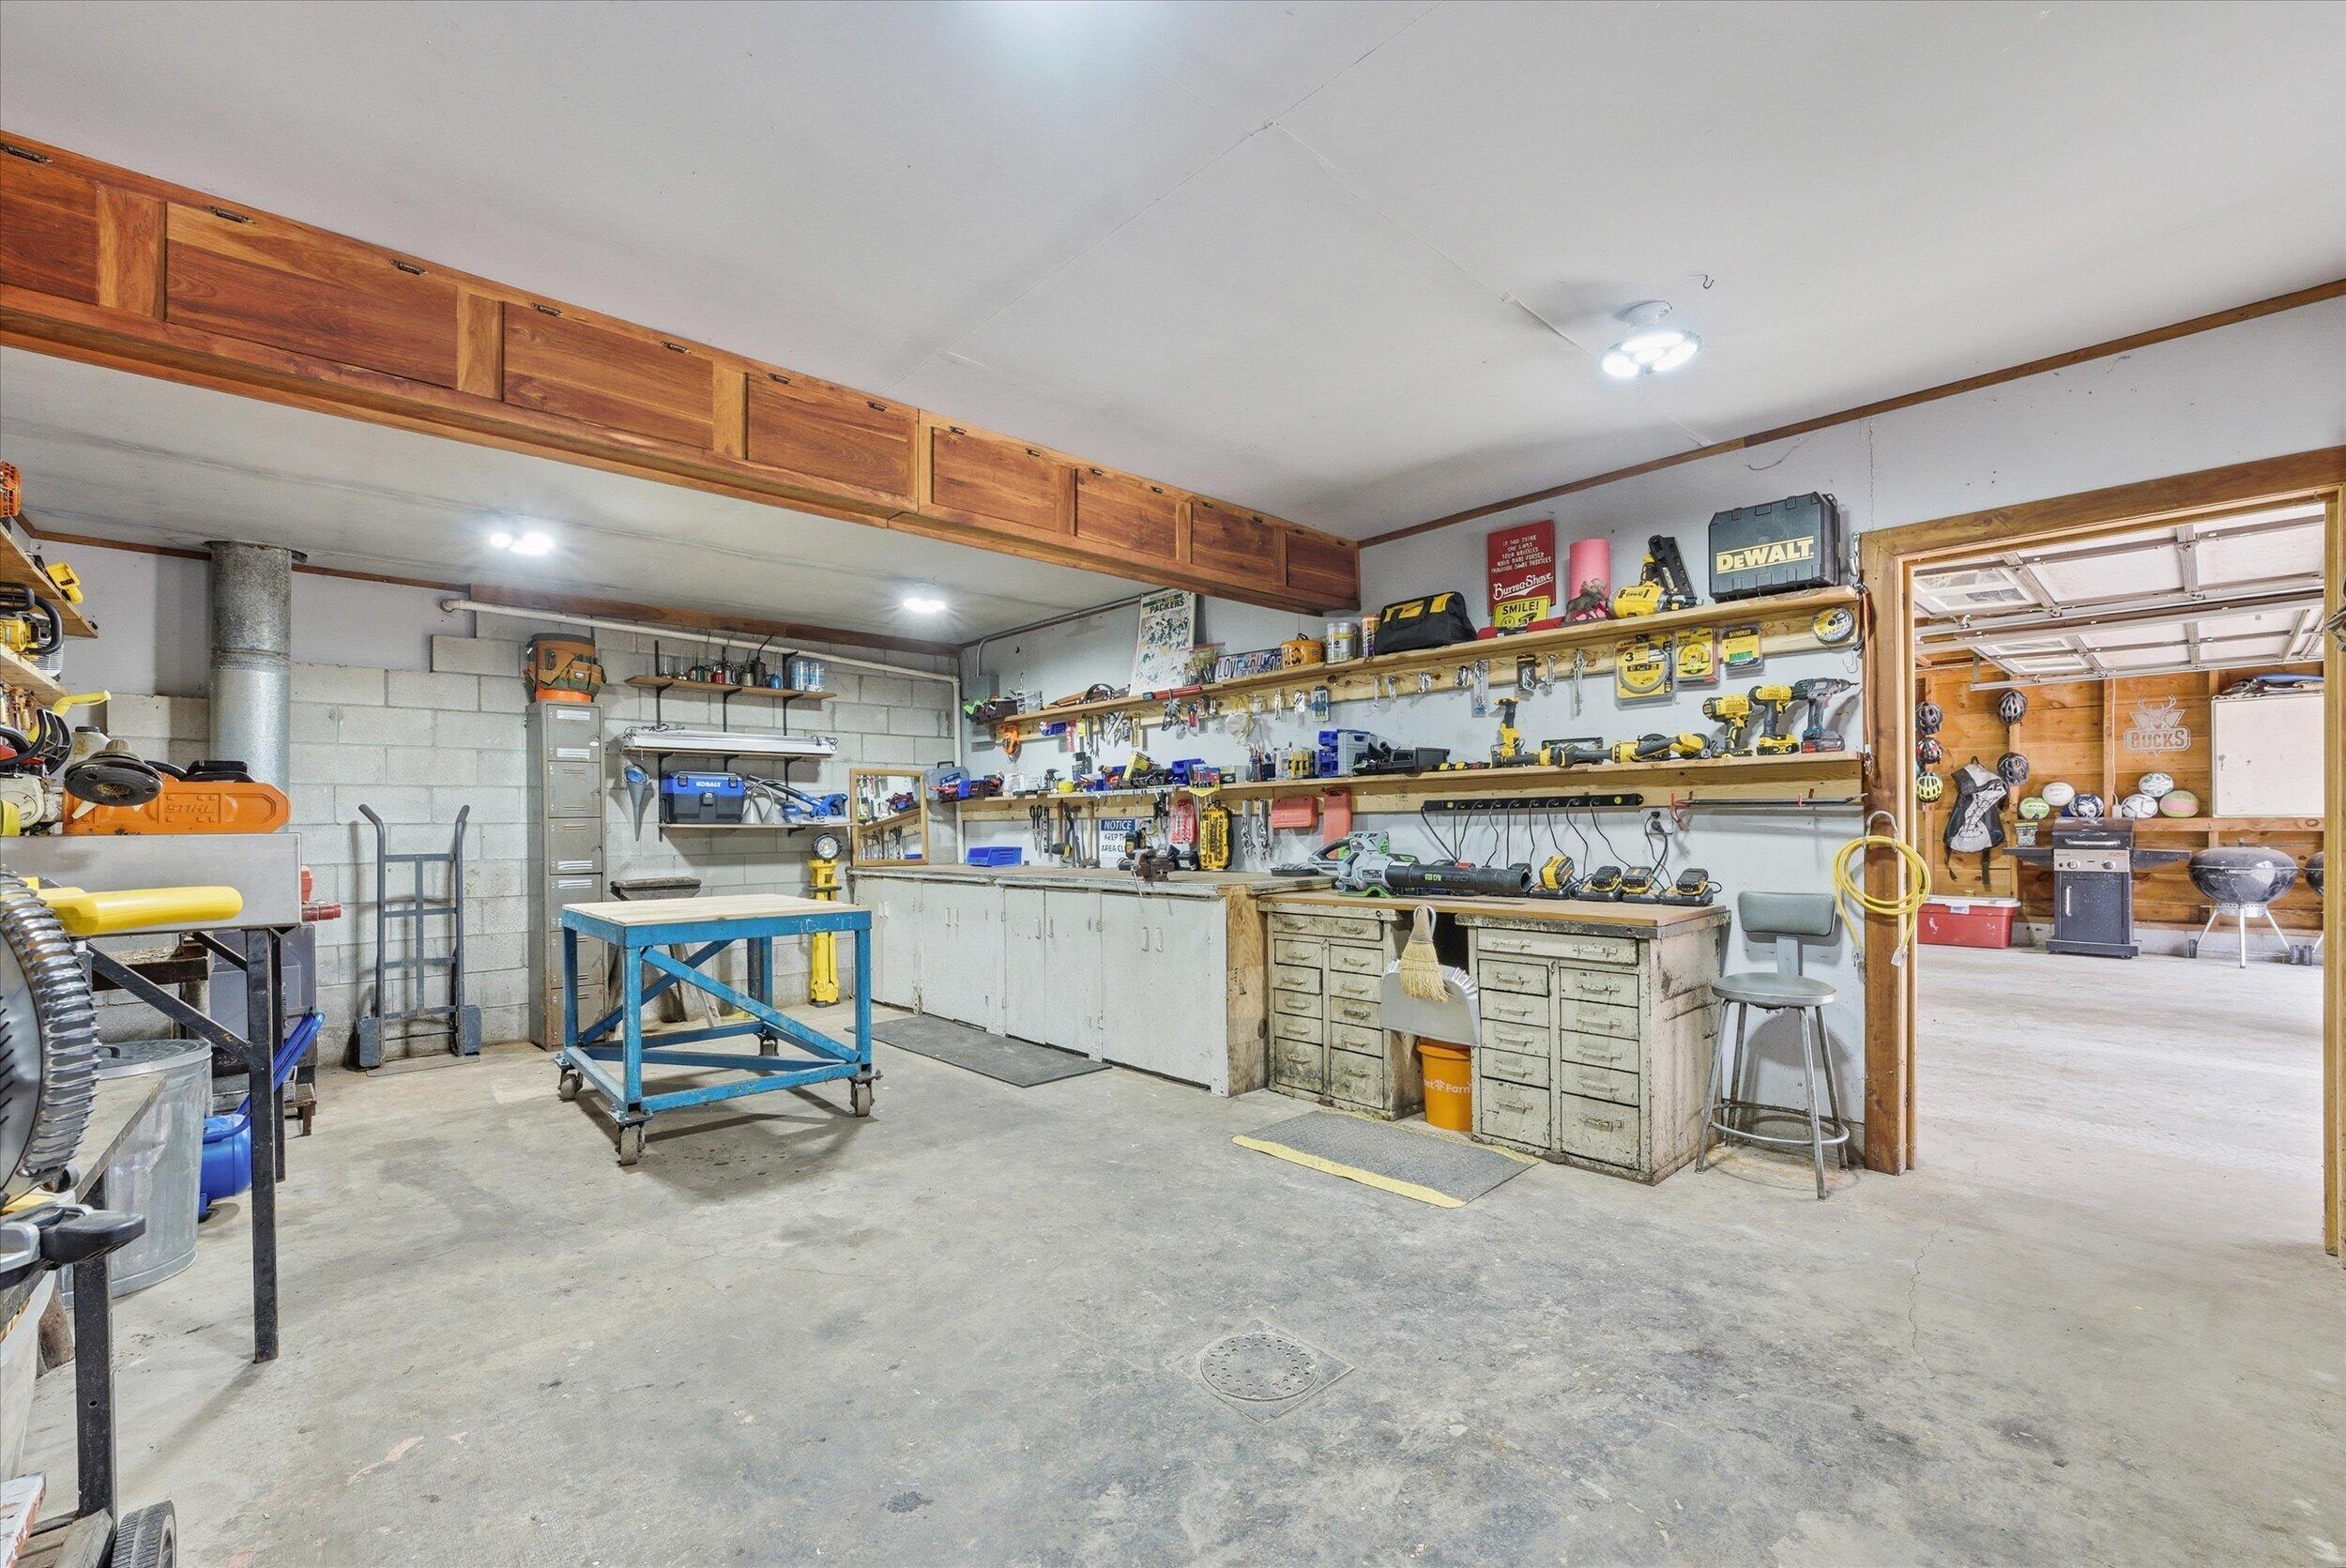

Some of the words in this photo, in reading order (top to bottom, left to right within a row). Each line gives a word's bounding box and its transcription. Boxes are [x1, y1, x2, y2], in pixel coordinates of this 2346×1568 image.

[1150, 598, 1185, 615] PACKERS
[1502, 601, 1539, 616] SMILE!
[1624, 651, 1634, 662] 3
[2131, 729, 2185, 748] BUCKS
[1104, 819, 1133, 831] NOTICE
[1104, 832, 1119, 842] KEEP
[1101, 844, 1117, 854] AREA
